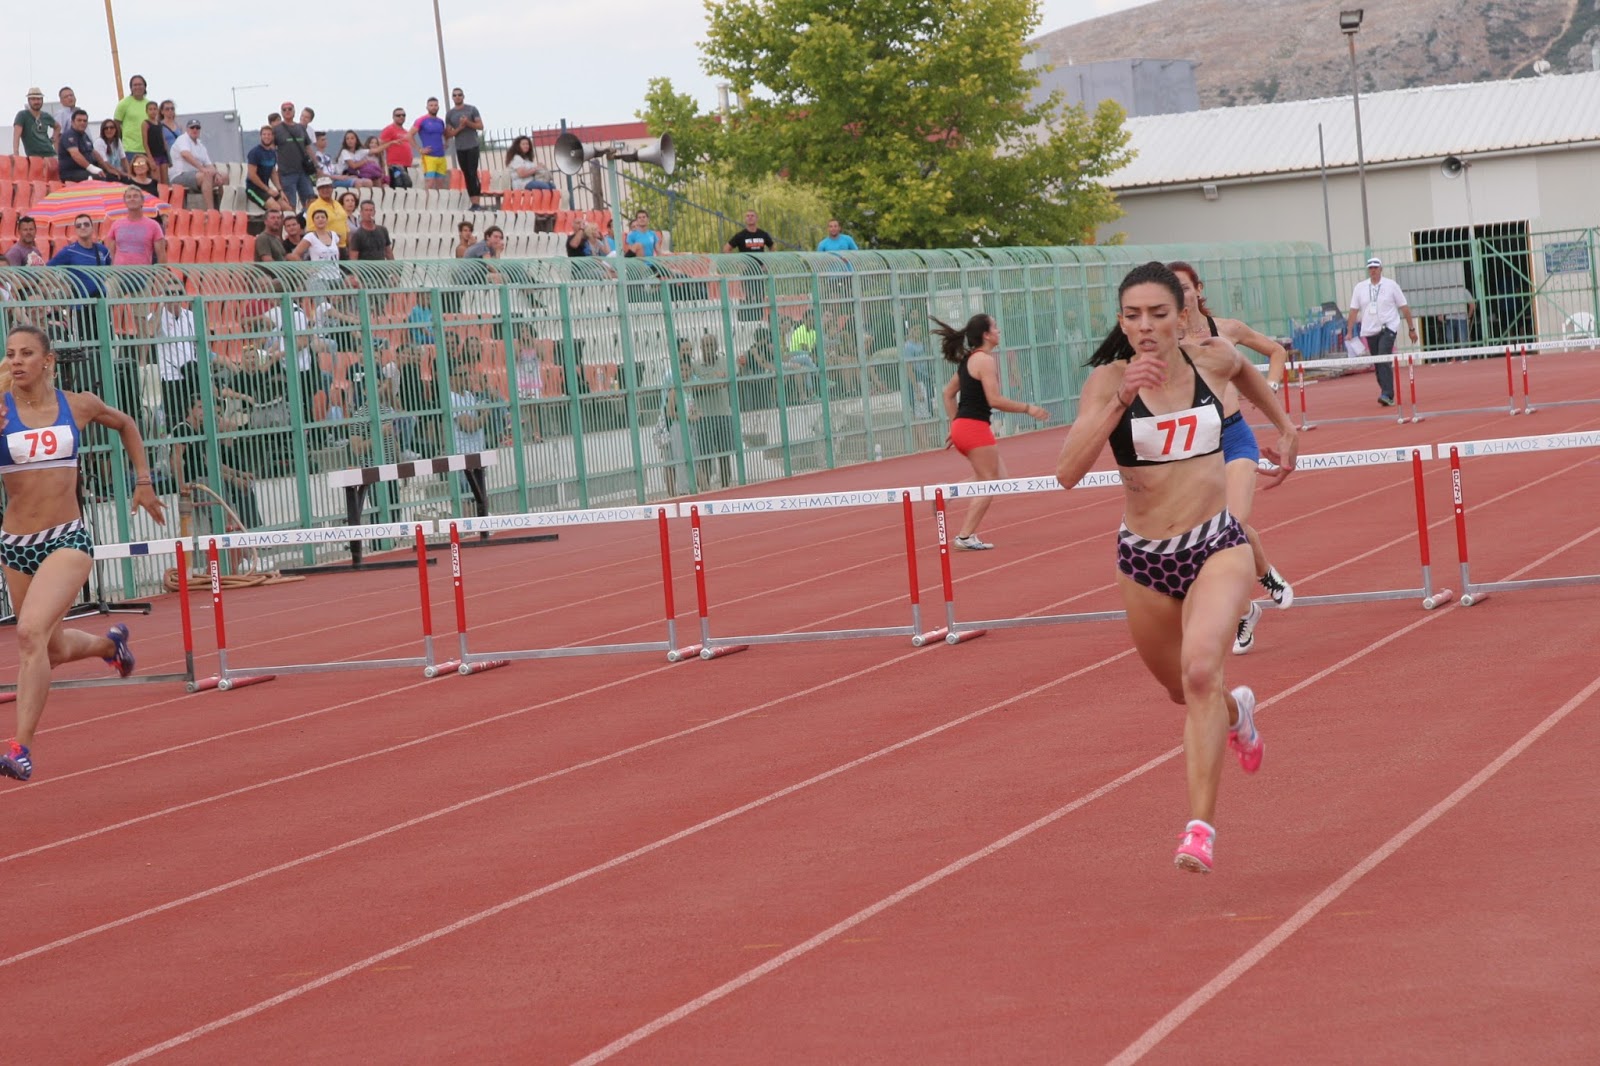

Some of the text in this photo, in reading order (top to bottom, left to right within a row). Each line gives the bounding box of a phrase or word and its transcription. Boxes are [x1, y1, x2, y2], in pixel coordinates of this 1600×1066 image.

[24, 430, 58, 458] 79
[1157, 415, 1197, 455] 77
[1482, 440, 1540, 453] ΔΗΜΟΣ
[1294, 452, 1388, 469] ΧΗΜΑΤΑΡΙΟΥ
[966, 482, 1020, 496] ΔΗΜΟΣ
[720, 492, 880, 513] ΔΗΜΟΣ ΣΧΗΜΑΤΑΡΙΟΥ
[479, 508, 638, 530] ΔΗΜΟΣ ΣΧΗΜΑΤΑΡΙΟΥ
[237, 526, 394, 546] ΔΗΜΟΣ ΣΧΗΜΑΤΑΡΙΟΥ
